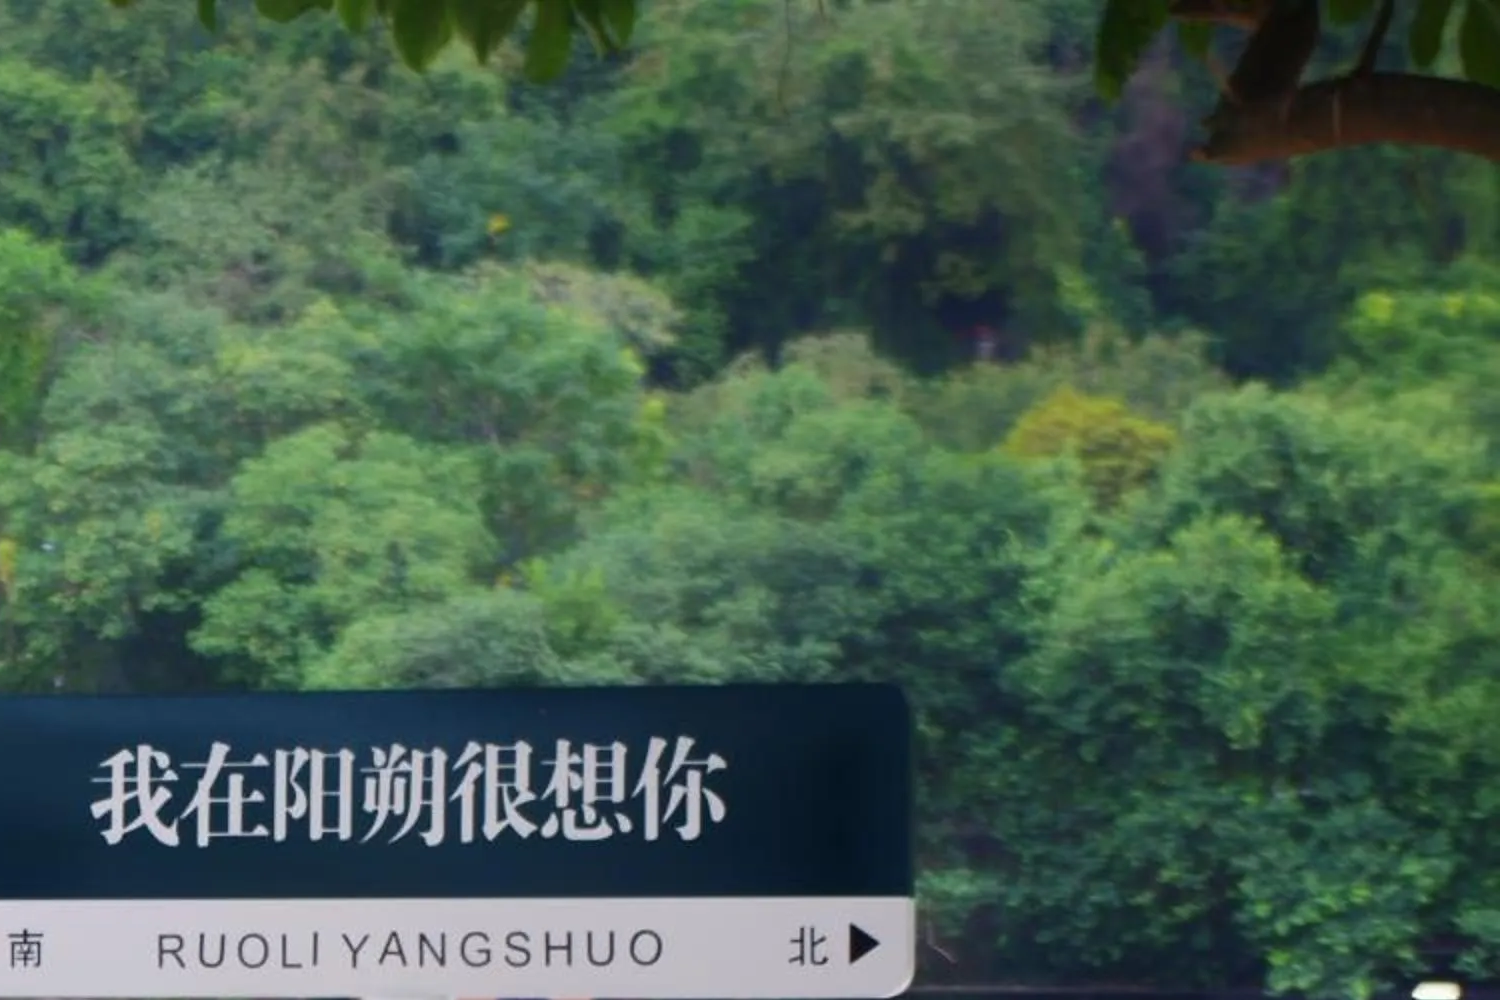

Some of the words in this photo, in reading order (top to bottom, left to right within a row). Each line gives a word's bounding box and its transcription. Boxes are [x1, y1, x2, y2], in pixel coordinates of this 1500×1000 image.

[90, 736, 727, 848] 我在阳朔很想你
[7, 928, 45, 969] 南
[156, 931, 320, 970] RUOLI
[341, 928, 664, 969] YANGSHUO
[788, 925, 830, 966] 北
